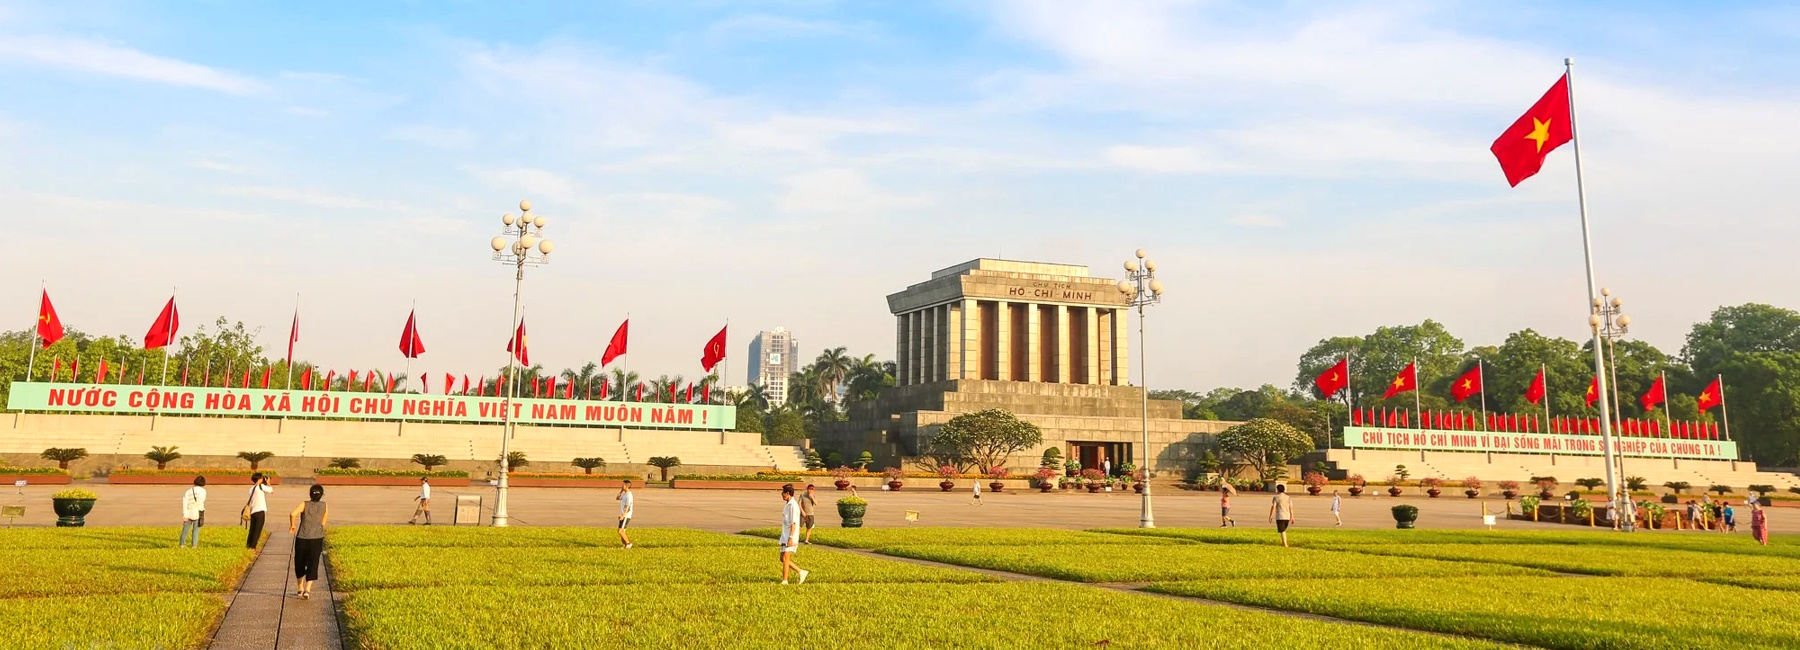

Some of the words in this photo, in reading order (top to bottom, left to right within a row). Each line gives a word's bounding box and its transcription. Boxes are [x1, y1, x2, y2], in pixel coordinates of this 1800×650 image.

[1063, 290, 1092, 301] MINH
[48, 386, 118, 407] NƯỚC
[128, 388, 195, 411] CỘNG
[205, 390, 252, 412] HÒA
[262, 391, 291, 412] XÃ
[302, 393, 339, 415] HỘI
[348, 394, 393, 415] CHỦ
[402, 396, 468, 417] NGHĨA
[478, 400, 523, 421] VIỆT
[531, 404, 576, 421] NAM
[585, 404, 642, 423] MUÔN
[651, 405, 694, 425] NĂM
[1362, 429, 1383, 444] CHỦ
[1387, 432, 1410, 447] TỊCH
[1451, 434, 1477, 448] MINH
[1494, 435, 1510, 451] ĐẠI
[1514, 434, 1540, 450] SỐNG
[1564, 438, 1595, 452] TRONG
[1650, 439, 1668, 454] CỦA
[1670, 441, 1701, 455] CHÚNG
[1703, 444, 1715, 456] TA
